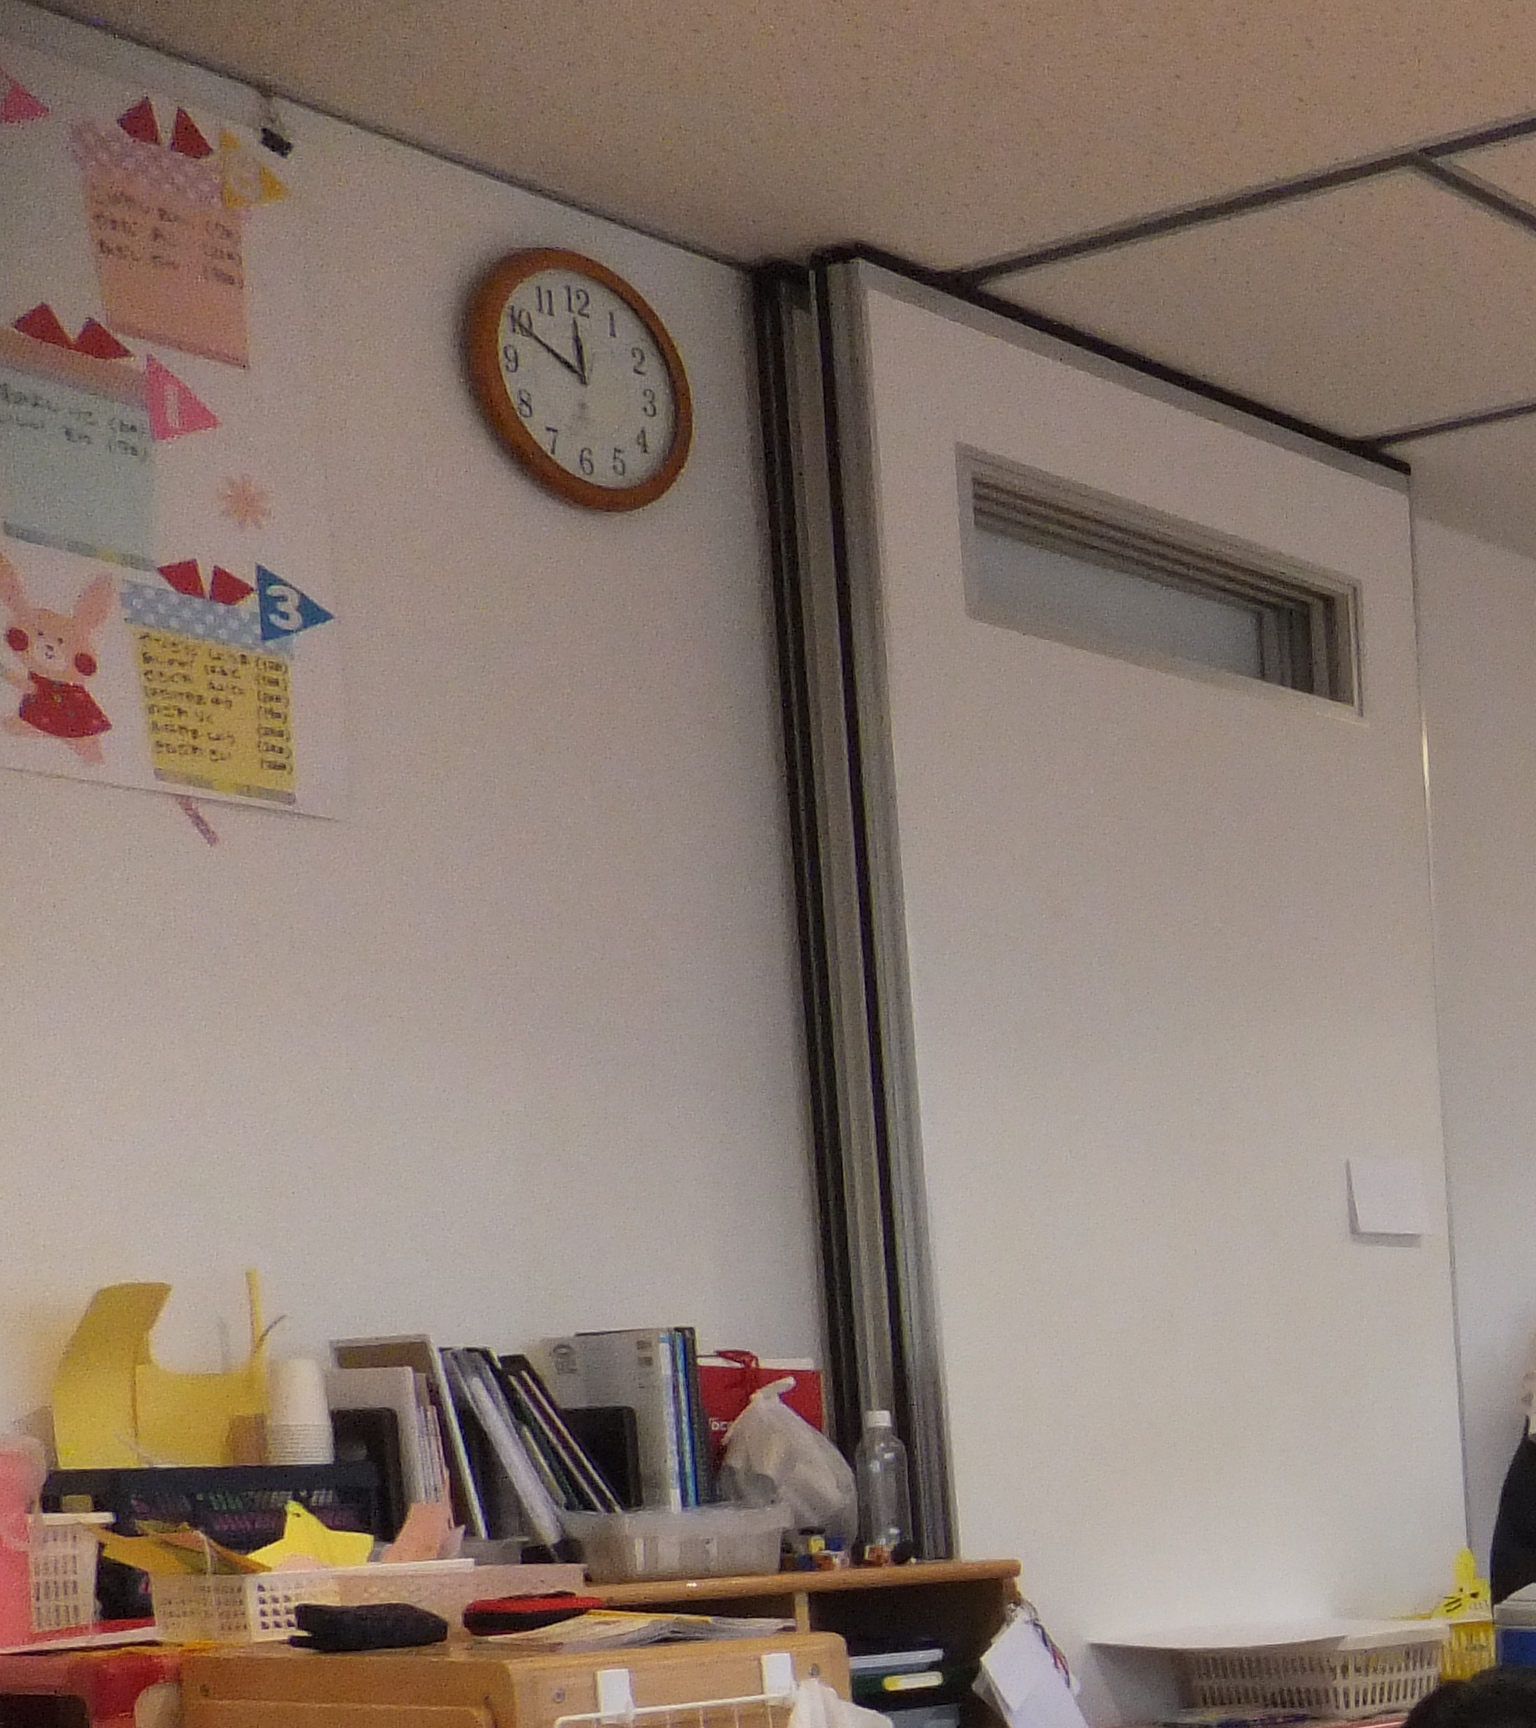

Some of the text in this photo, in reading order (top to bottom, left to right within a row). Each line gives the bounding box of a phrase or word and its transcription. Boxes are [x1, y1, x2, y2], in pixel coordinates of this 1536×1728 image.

[535, 285, 555, 317] 11
[564, 285, 590, 318] 12
[510, 304, 533, 337] 10
[608, 311, 617, 338] 1
[503, 344, 519, 373] 9
[631, 347, 646, 375] 2
[517, 389, 533, 418] 8
[642, 388, 657, 417] 3
[545, 426, 558, 455] 7
[636, 426, 649, 453] 4
[579, 447, 594, 476] 6
[612, 447, 626, 476] 5
[266, 584, 303, 632] 3
